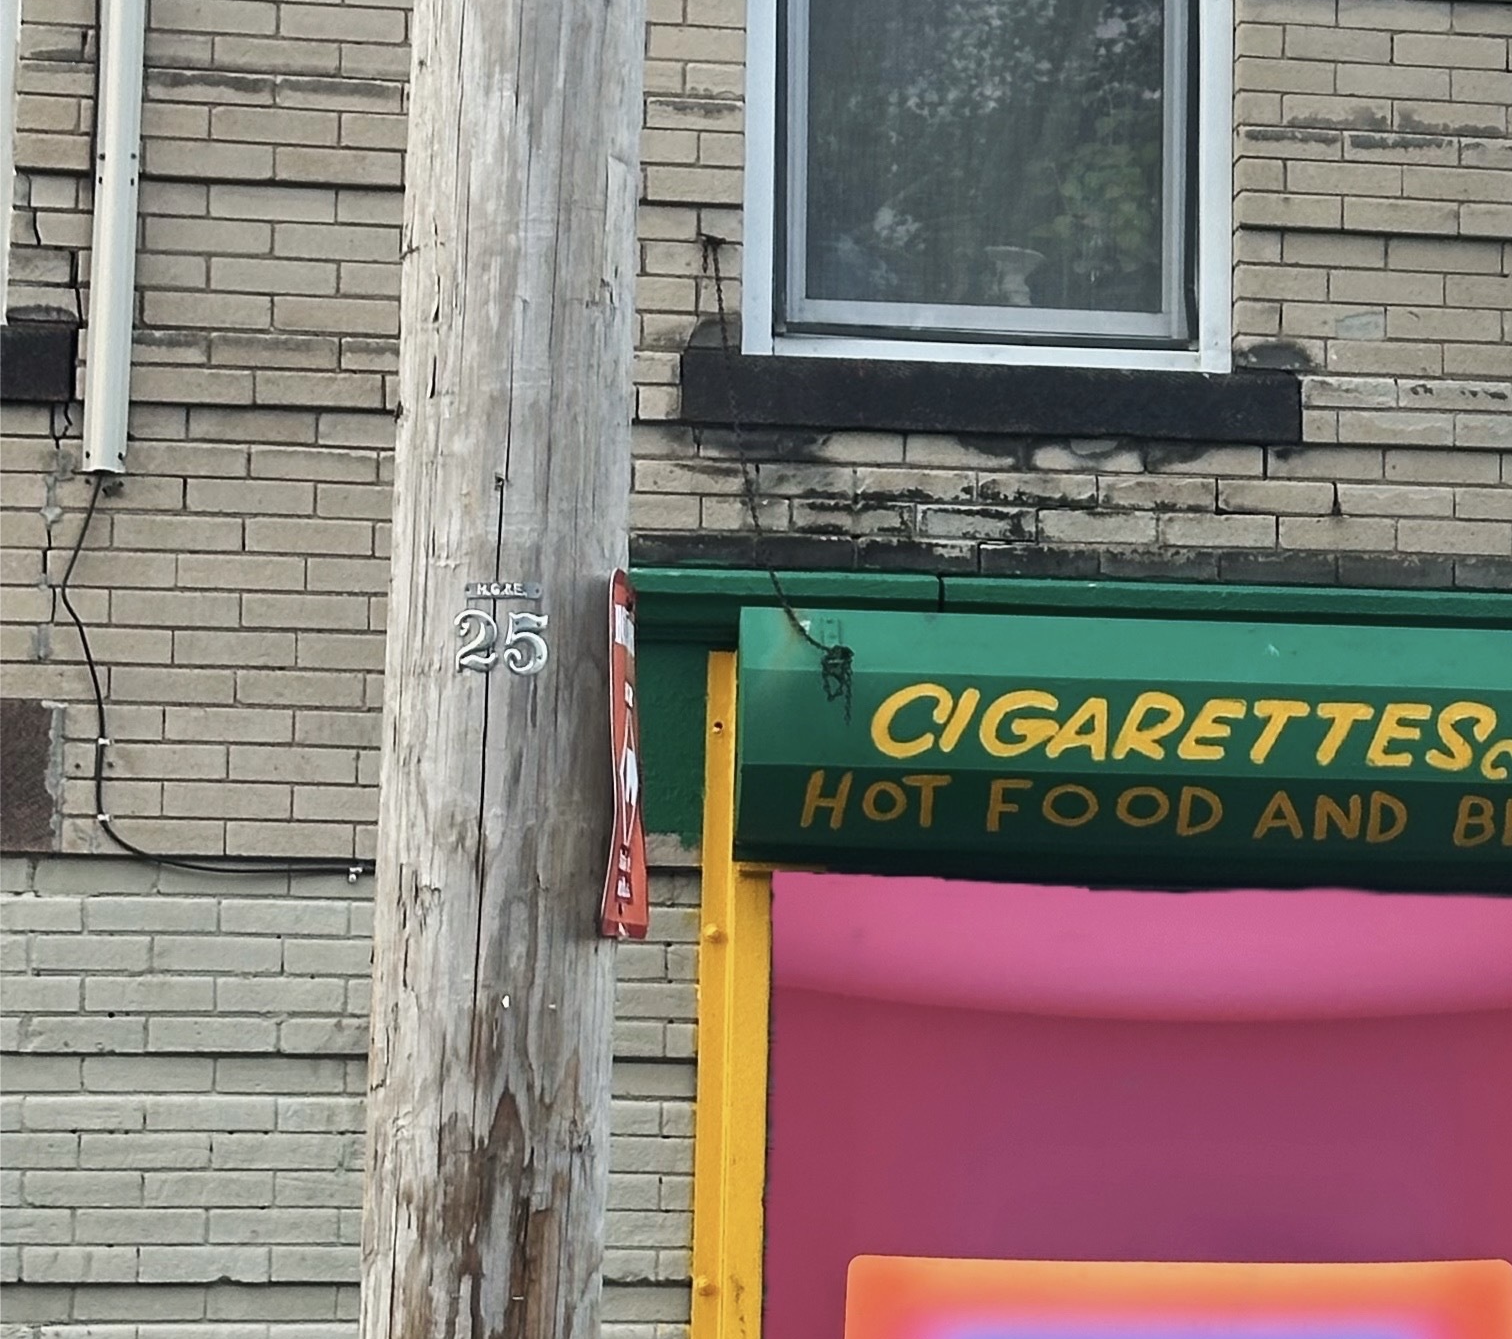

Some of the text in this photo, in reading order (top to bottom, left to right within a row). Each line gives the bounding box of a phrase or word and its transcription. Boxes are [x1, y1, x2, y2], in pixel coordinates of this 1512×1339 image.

[453, 609, 549, 675] 25
[870, 682, 1498, 771] CIGARETTES
[801, 770, 952, 829] HOT
[986, 778, 1224, 837] FOOD
[1253, 790, 1409, 844] AND
